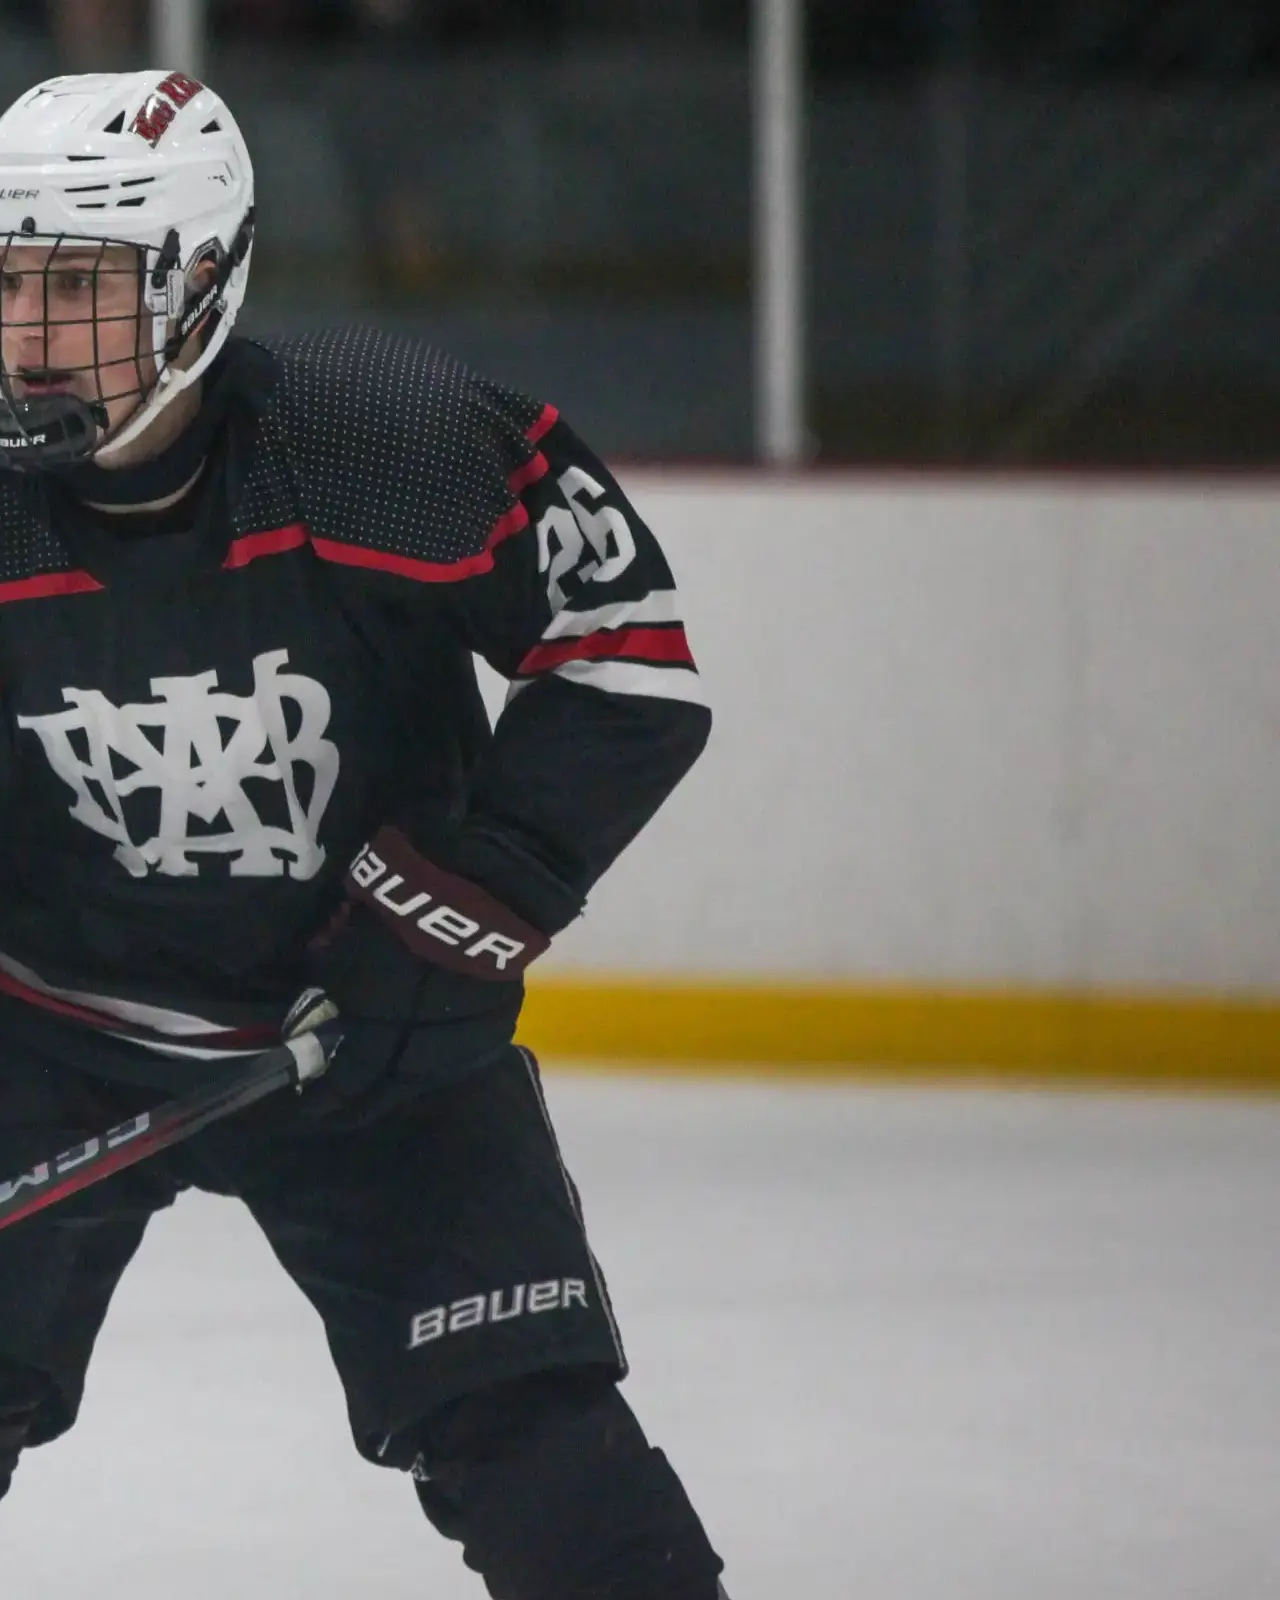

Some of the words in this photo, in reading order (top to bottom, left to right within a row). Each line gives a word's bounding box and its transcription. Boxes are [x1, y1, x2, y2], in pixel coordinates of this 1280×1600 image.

[536, 465, 636, 620] 26
[350, 843, 525, 970] AUER
[408, 1277, 588, 1350] BAUER
